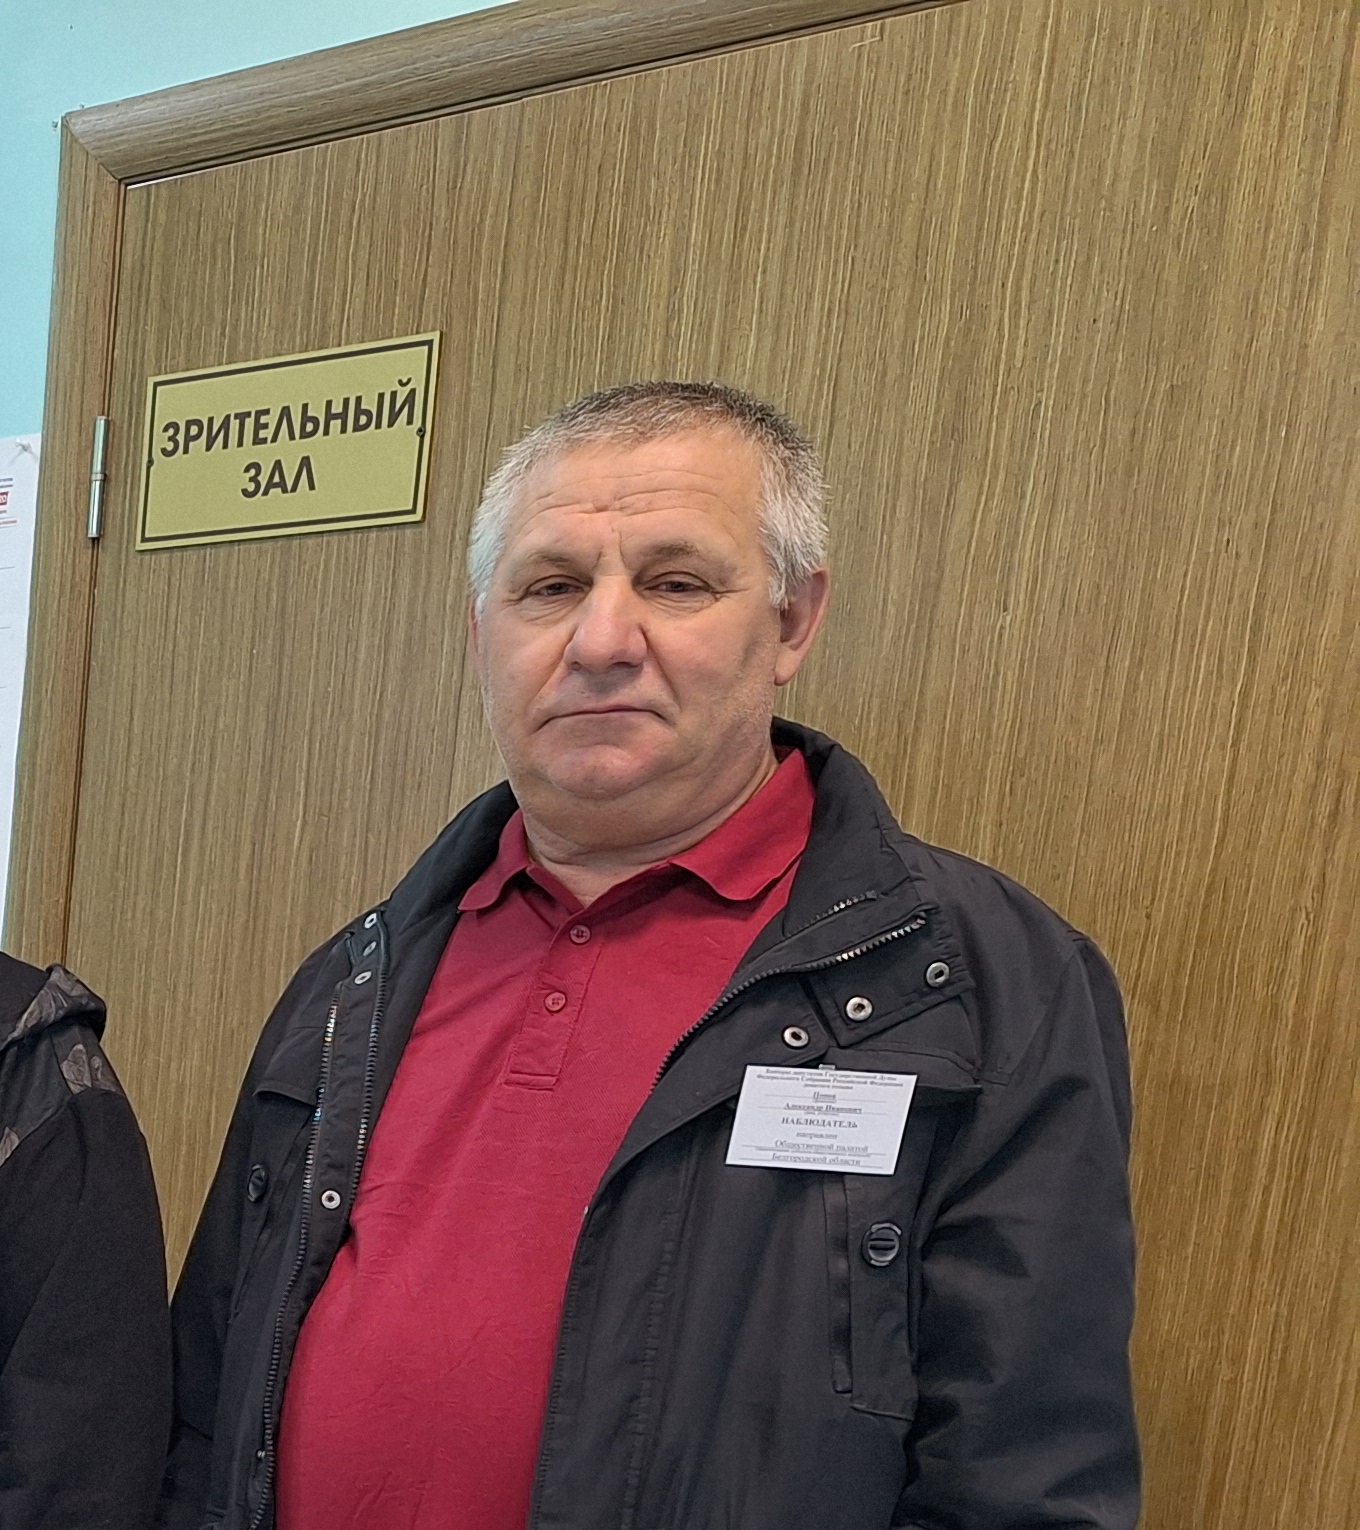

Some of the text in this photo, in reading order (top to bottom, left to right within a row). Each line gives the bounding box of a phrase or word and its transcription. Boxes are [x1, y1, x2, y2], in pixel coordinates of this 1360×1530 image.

[160, 376, 418, 458] ЗРИТЕЛЬНЫЙ
[240, 455, 317, 499] ЗАЛ
[781, 1116, 858, 1129] НАБЛЮДАТЕЛЬ
